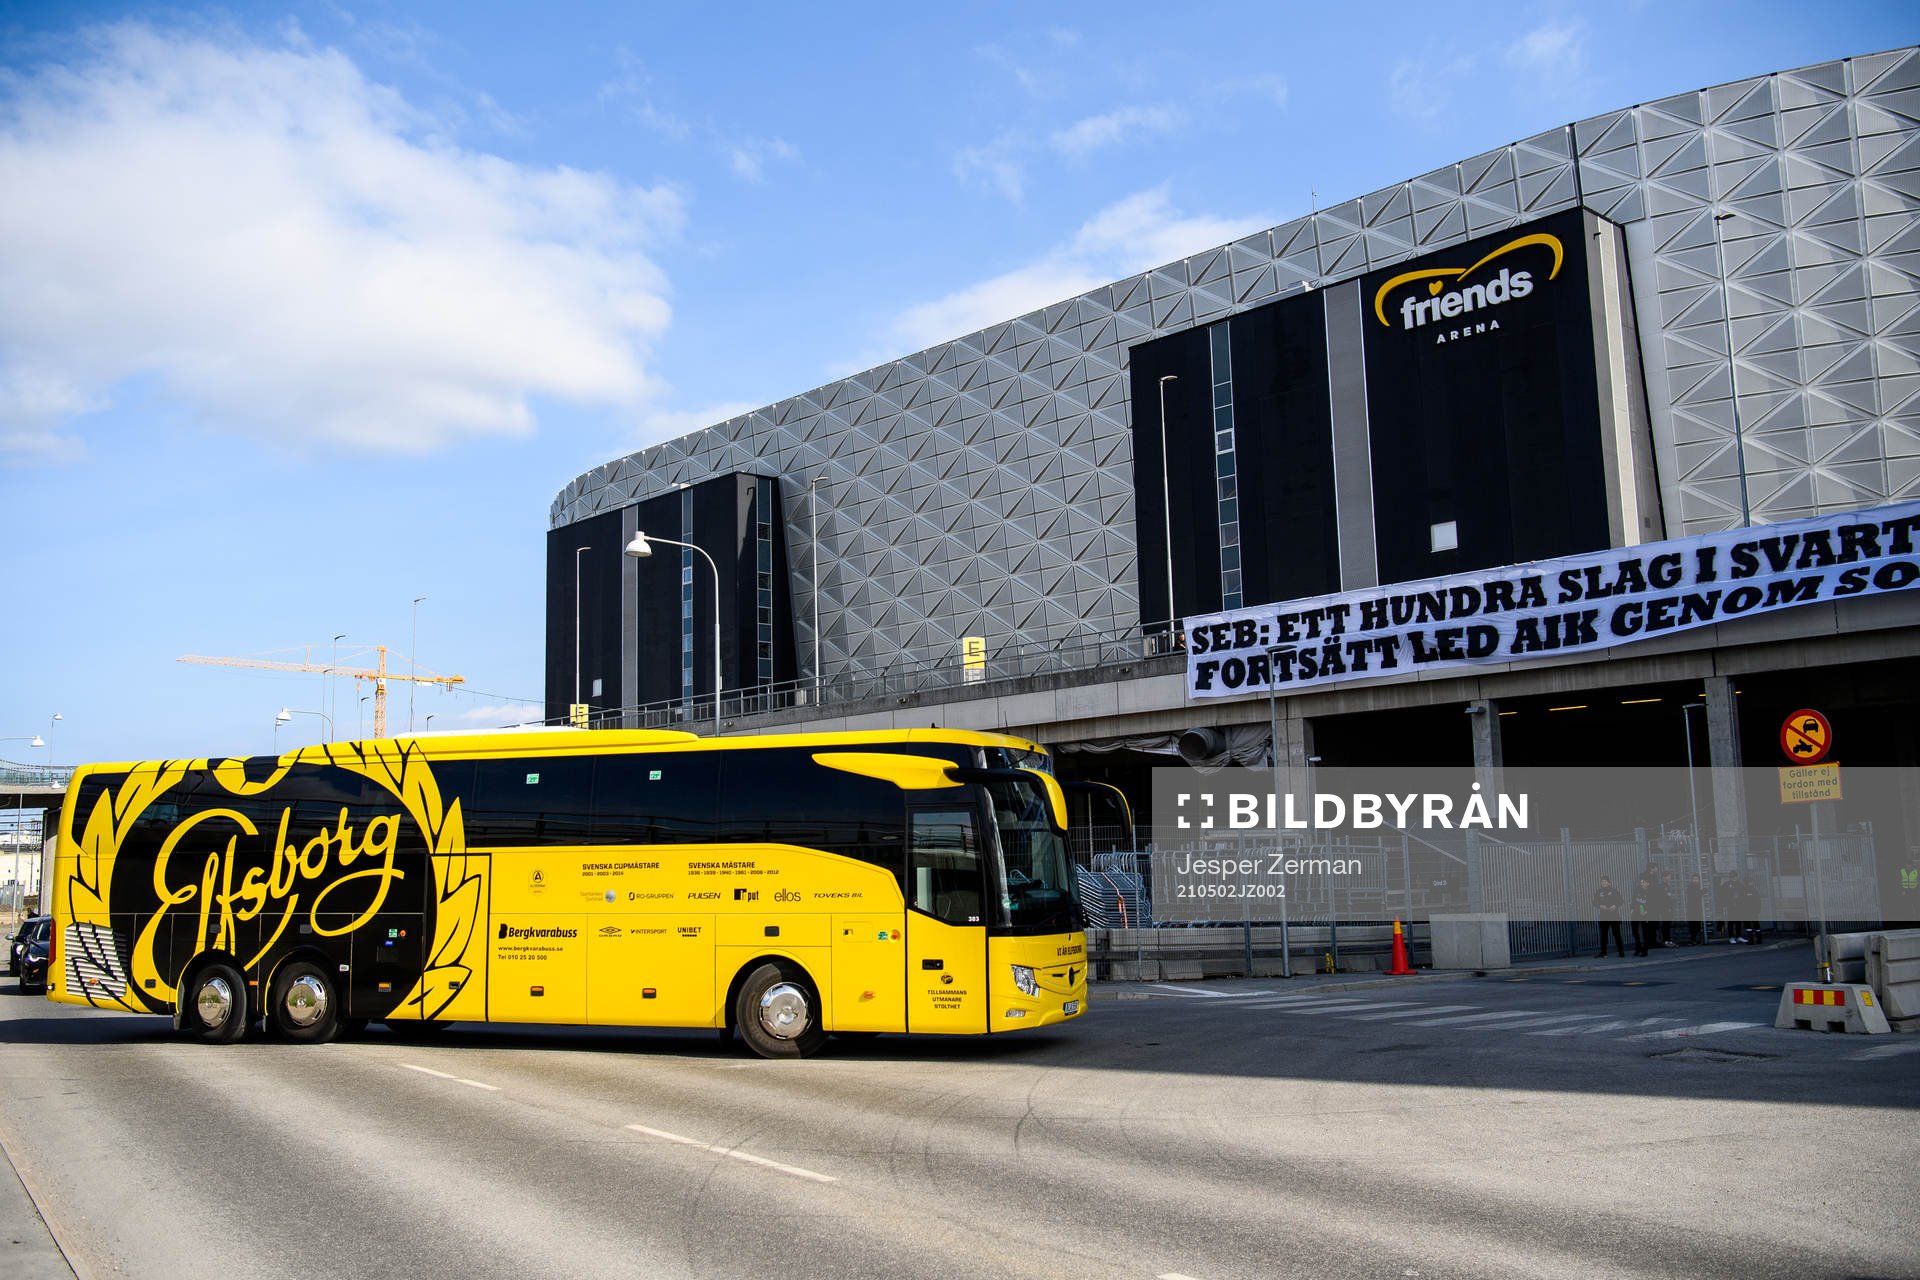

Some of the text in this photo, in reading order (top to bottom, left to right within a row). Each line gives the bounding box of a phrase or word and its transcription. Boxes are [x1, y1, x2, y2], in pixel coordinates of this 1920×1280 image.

[1400, 268, 1534, 330] friends
[1436, 319, 1500, 344] ARENA
[1191, 514, 1920, 655] SEB: ETT HUNDRA SLAG I SVART
[1195, 561, 1920, 690] FORTSÄTT LED AIK GENOM SO
[969, 641, 980, 656] E
[1789, 766, 1830, 778] Gäller ej
[1783, 777, 1838, 789] fordon med
[1792, 788, 1831, 799] tillstånd
[774, 888, 801, 902] ellos
[508, 926, 578, 939] Bergkvarabuss
